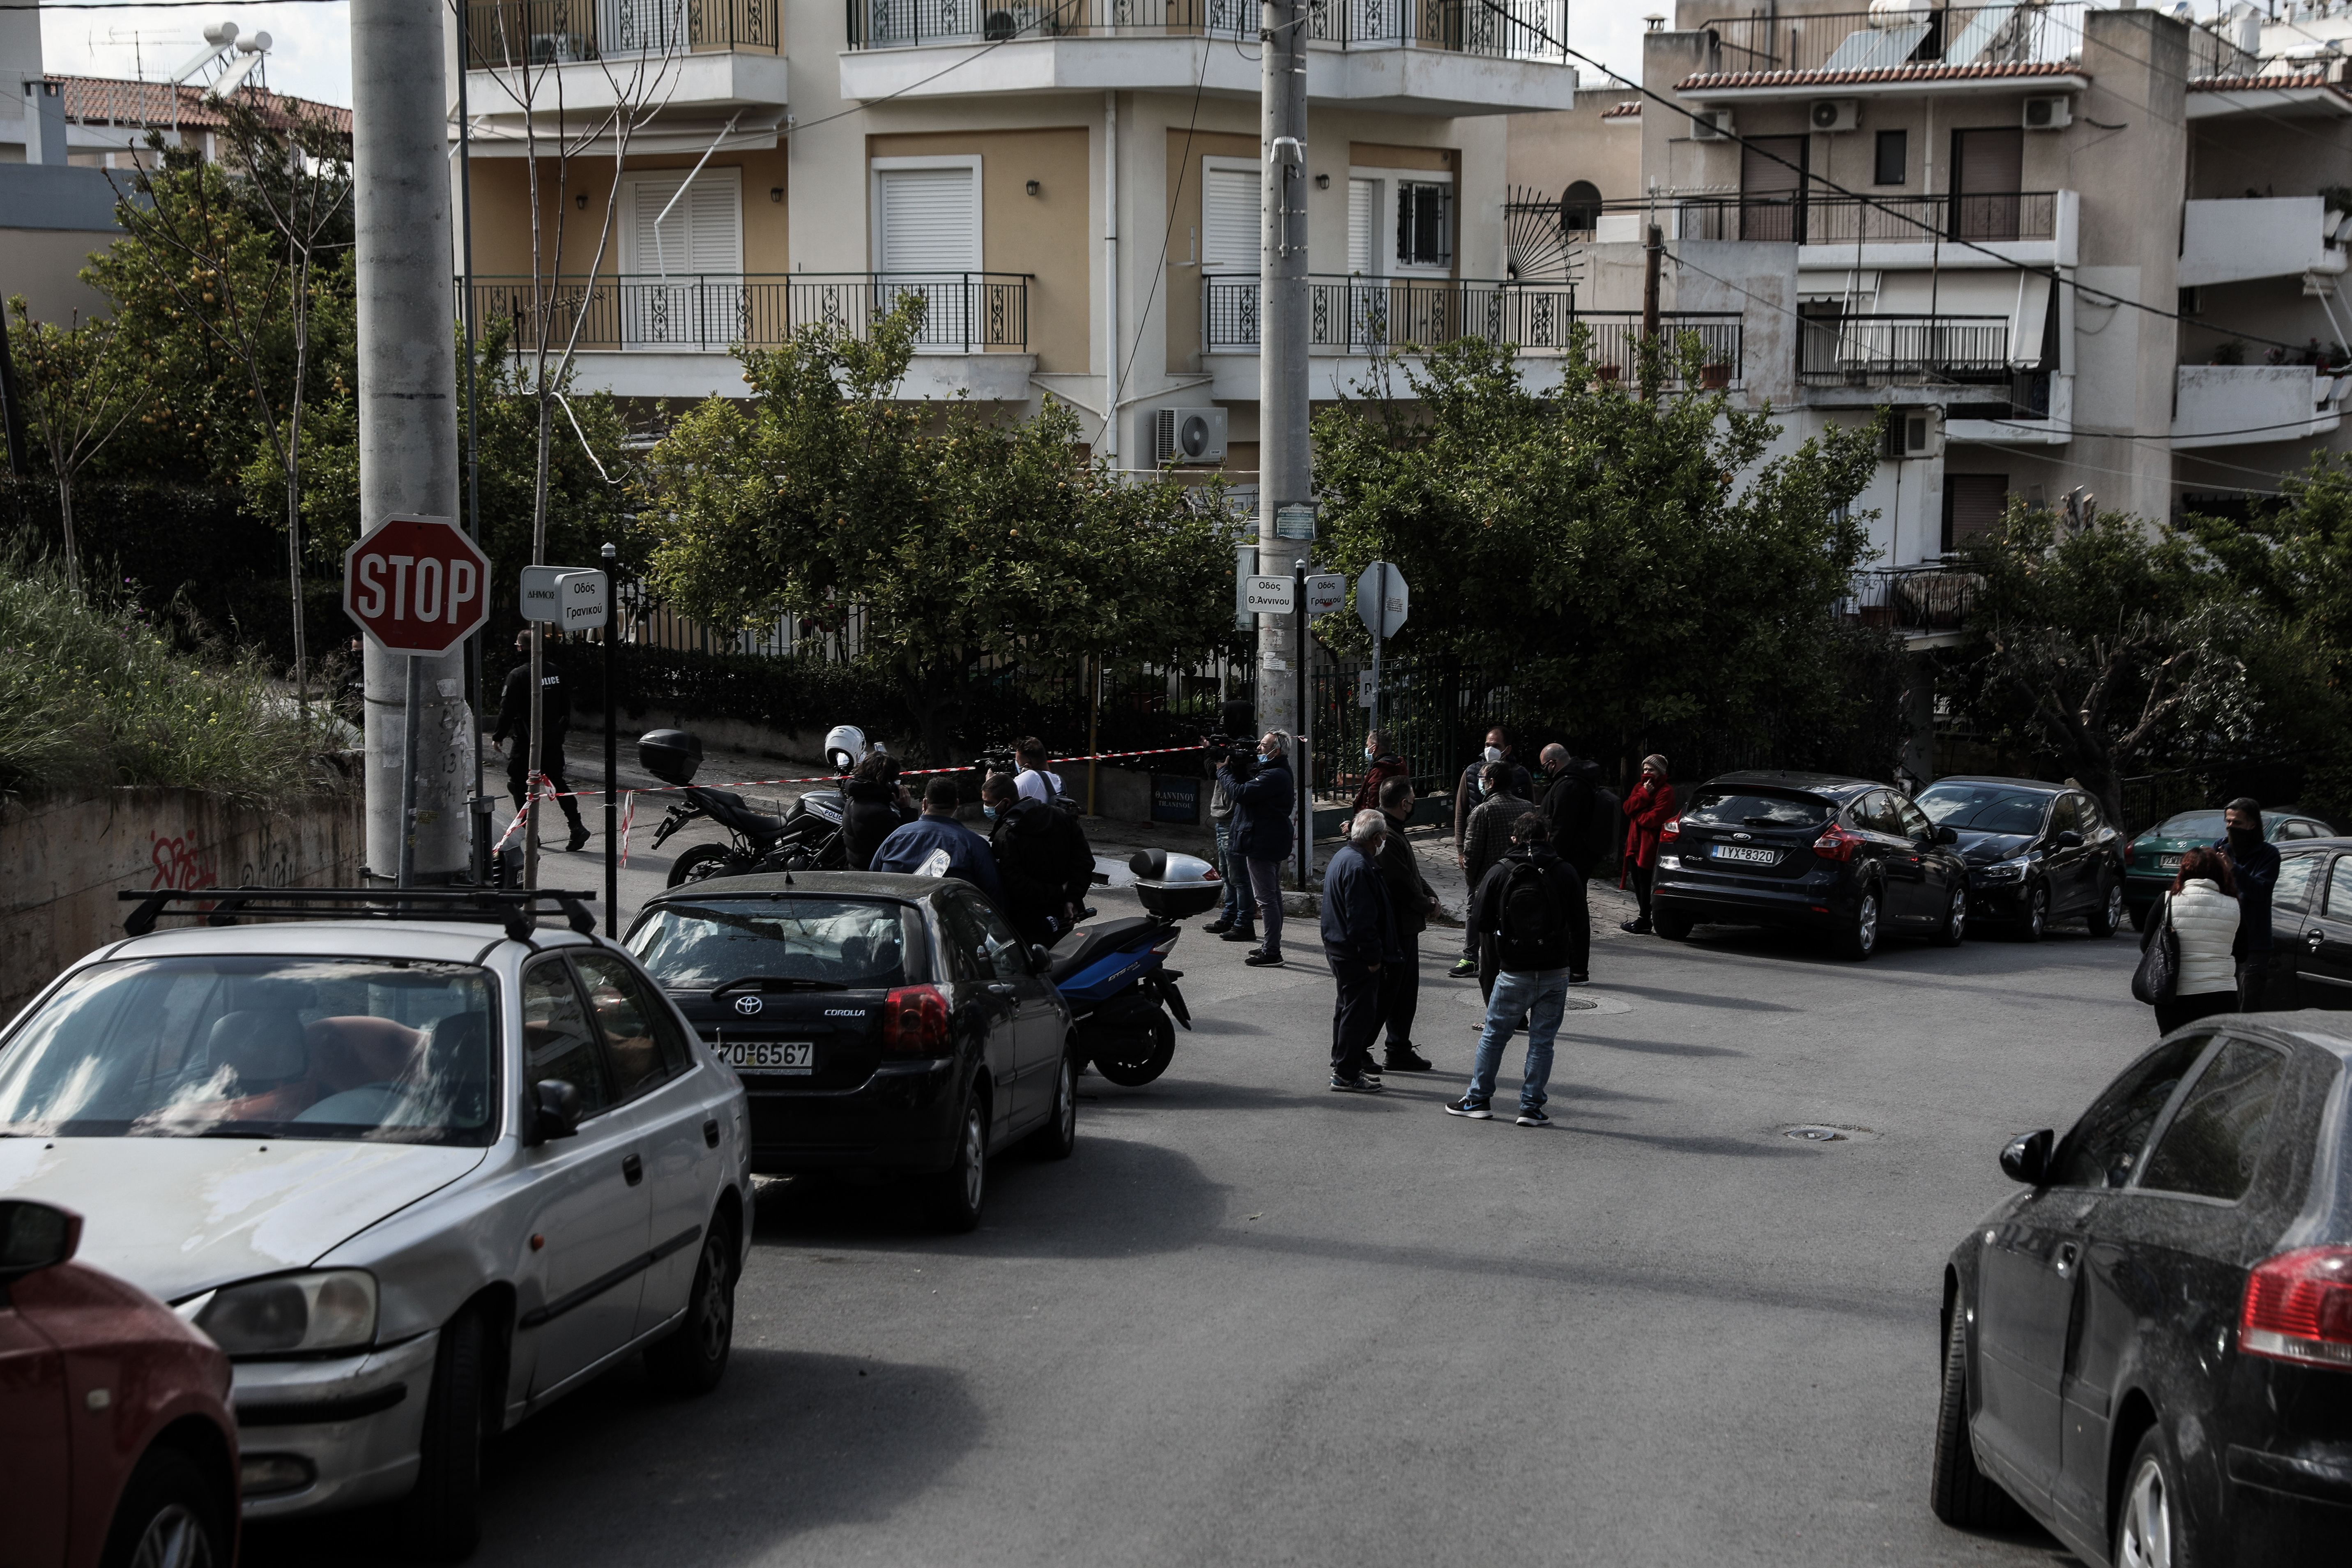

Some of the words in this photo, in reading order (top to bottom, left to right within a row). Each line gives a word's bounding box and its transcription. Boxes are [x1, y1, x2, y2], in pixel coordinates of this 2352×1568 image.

[358, 553, 476, 624] STOP
[574, 582, 595, 594] Οδός
[1259, 581, 1281, 591] Οδός
[1317, 581, 1335, 589] Οδός
[527, 590, 555, 599] ΔΗΜΟΣ
[1248, 596, 1290, 606] Θ.Άννινου
[1311, 595, 1341, 606] Γρανικού
[566, 603, 603, 620] Γρανικού
[541, 676, 560, 686] OLICE
[823, 801, 843, 812] Kawasaki
[824, 810, 843, 820] POLIC
[711, 1043, 810, 1064] ZO-6567
